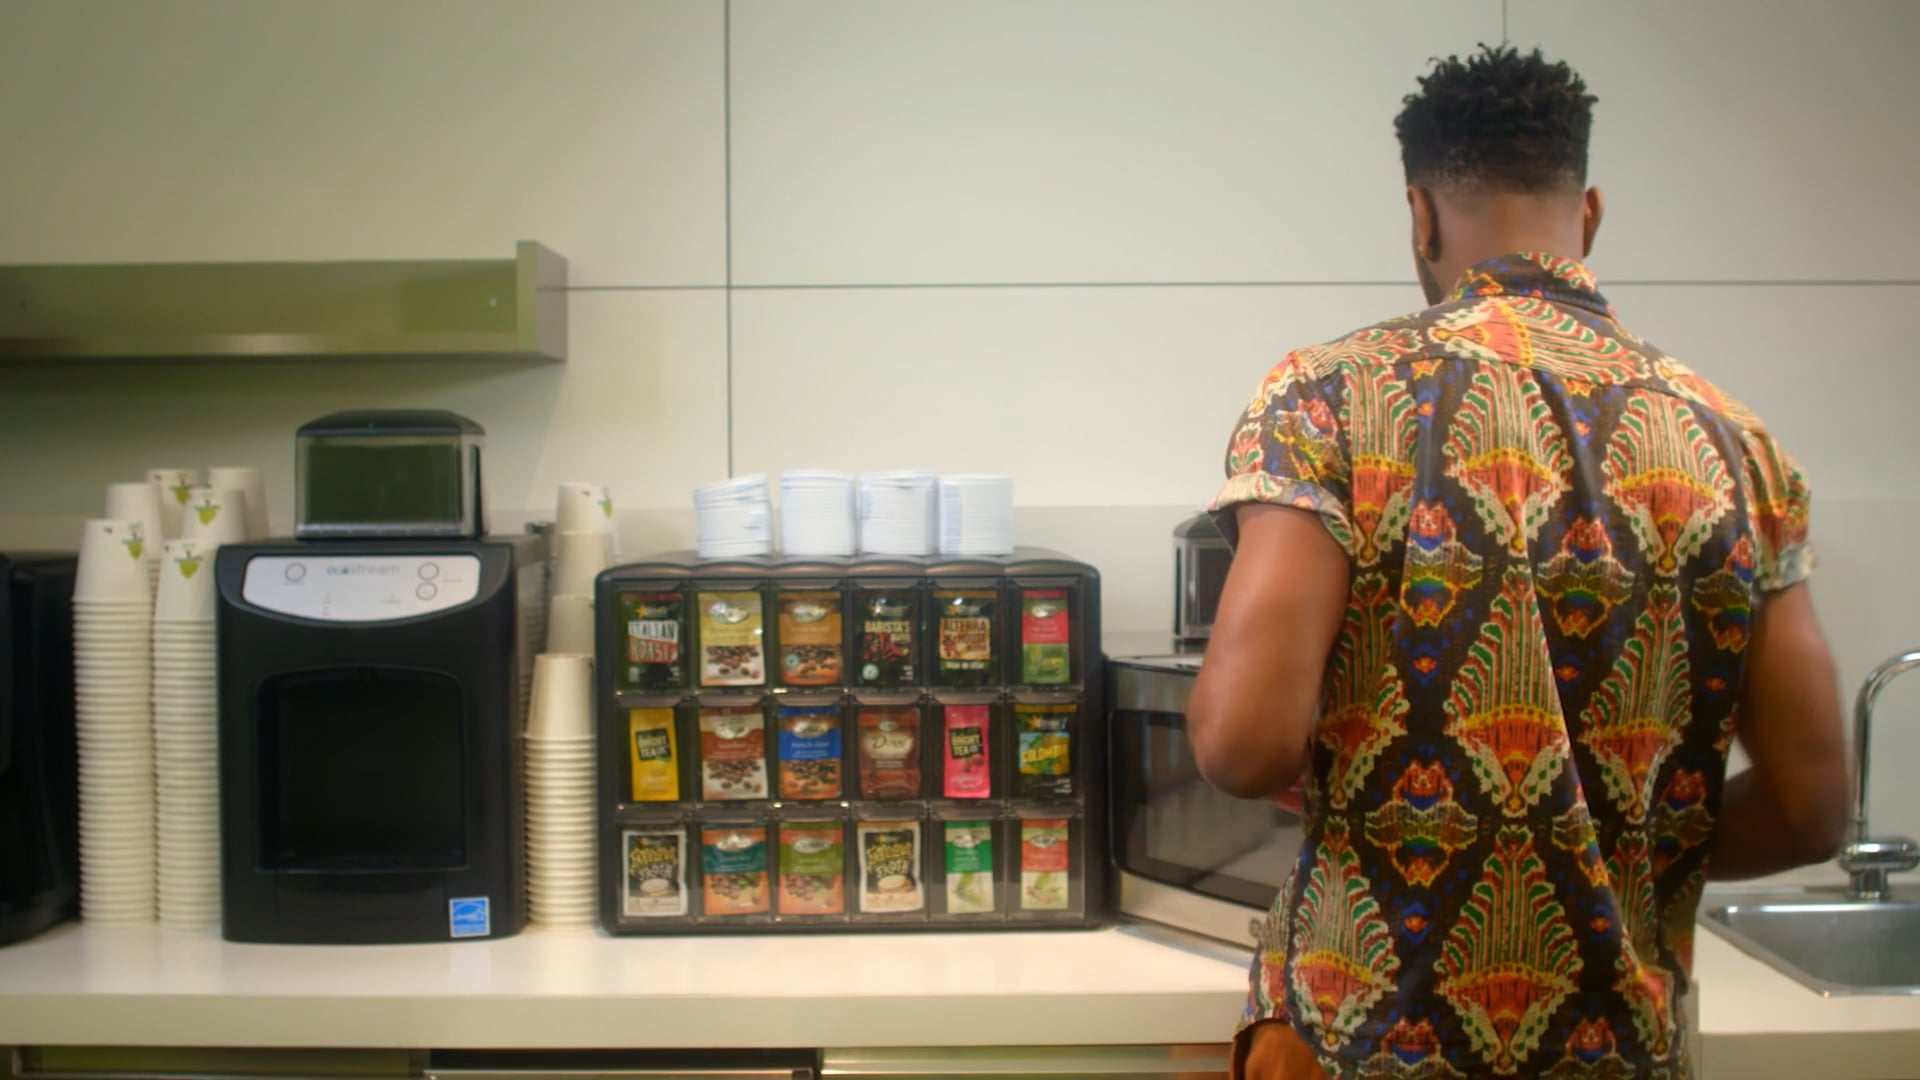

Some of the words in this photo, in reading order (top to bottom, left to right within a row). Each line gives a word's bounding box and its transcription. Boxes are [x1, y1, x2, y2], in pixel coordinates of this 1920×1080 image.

[630, 621, 676, 641] ITALIAN
[864, 621, 910, 633] BARISTA'S
[944, 619, 987, 631] ALTERRA
[630, 637, 672, 662] ROAST
[641, 747, 657, 758] TEA
[953, 746, 970, 757] TEA
